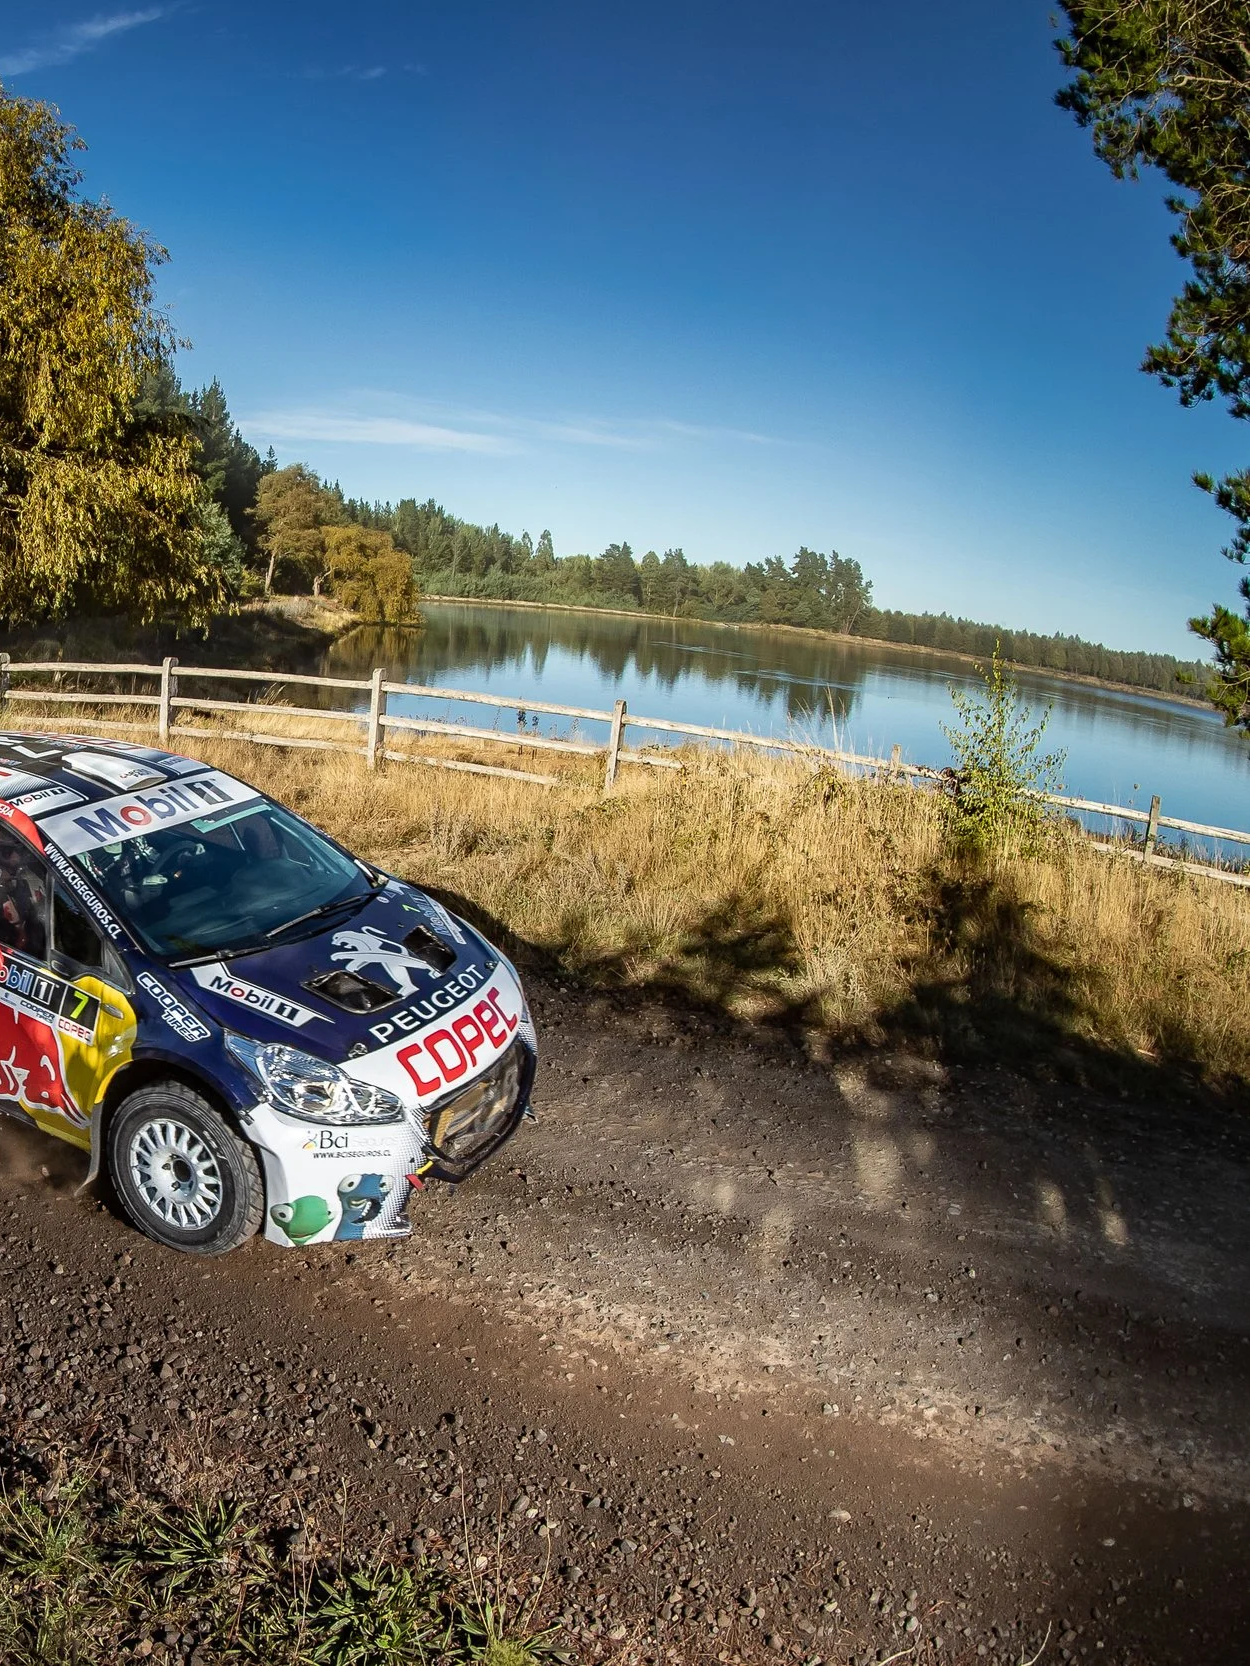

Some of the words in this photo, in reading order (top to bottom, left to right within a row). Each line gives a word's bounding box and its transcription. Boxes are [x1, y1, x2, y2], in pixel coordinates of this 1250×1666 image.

[9, 791, 51, 808] Mobil
[50, 787, 68, 796] 1
[72, 786, 199, 843] Mobil
[183, 780, 234, 805] 1
[44, 842, 122, 940] WWW.BCISEGUROS.CL
[20, 1000, 55, 1020] COOPER
[70, 991, 89, 1019] 7
[138, 972, 211, 1040] COOPER
[209, 976, 276, 1010] Mobil
[274, 1002, 300, 1021] 1
[368, 964, 485, 1044] PEUGEOT
[162, 1009, 201, 1042] TIRES
[320, 1130, 348, 1149] Bci
